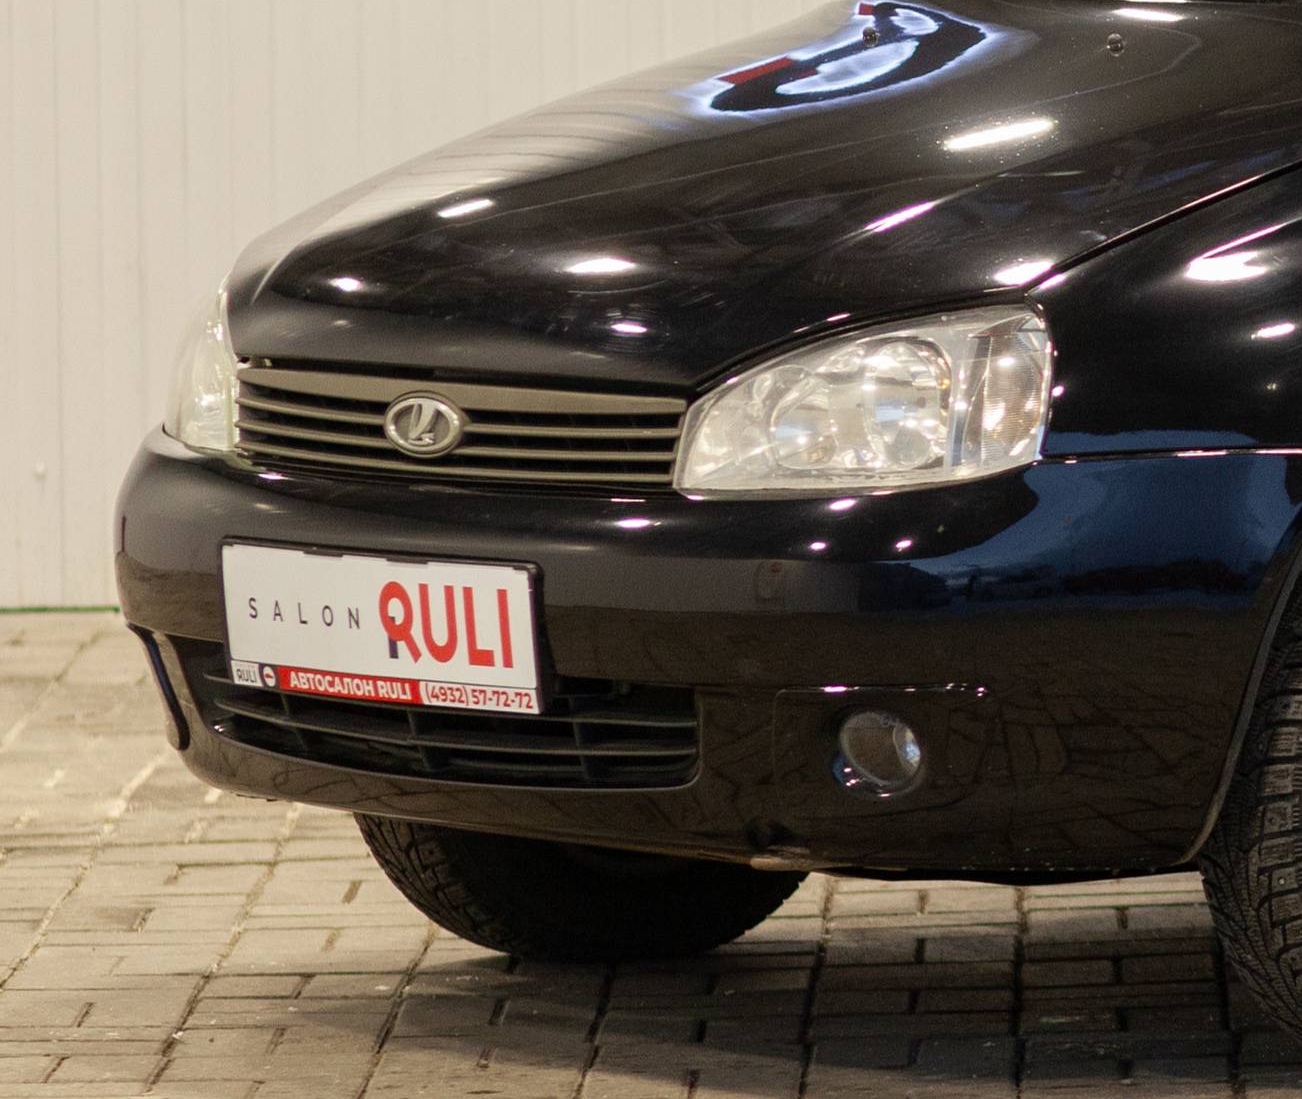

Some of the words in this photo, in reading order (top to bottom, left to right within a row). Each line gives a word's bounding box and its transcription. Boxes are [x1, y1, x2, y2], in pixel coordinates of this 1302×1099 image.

[248, 597, 361, 630] SALON
[378, 580, 514, 669] RULI
[236, 668, 258, 683] RULI
[290, 670, 376, 697] АВТОСАЛОН
[376, 679, 413, 700] RULI
[425, 682, 469, 706] (4932)
[470, 688, 534, 710] 57-72-72
